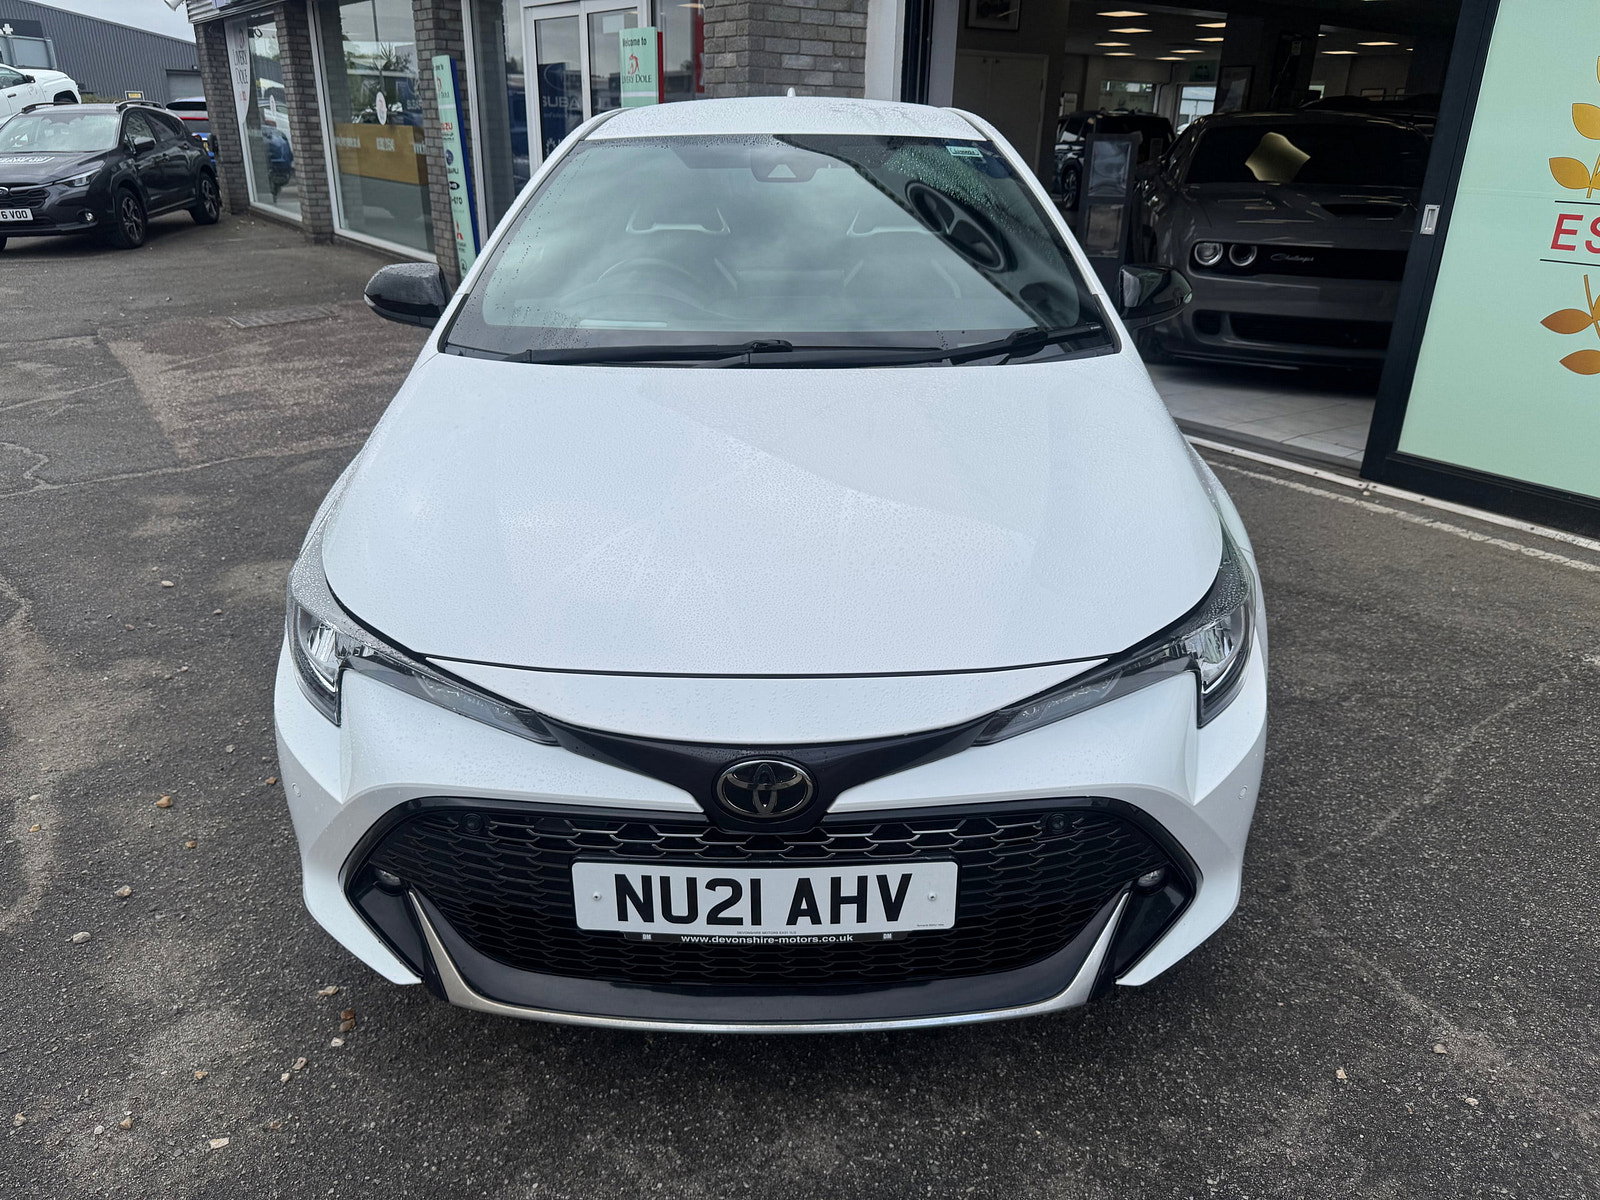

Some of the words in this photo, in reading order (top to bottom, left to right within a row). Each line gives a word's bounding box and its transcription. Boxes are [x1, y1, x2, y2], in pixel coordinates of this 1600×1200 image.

[641, 36, 648, 46] to
[635, 74, 652, 83] DOLE
[614, 873, 762, 927] NU21
[786, 873, 913, 926] AHV
[681, 934, 853, 945] www.devonshire-motors.co.uk
